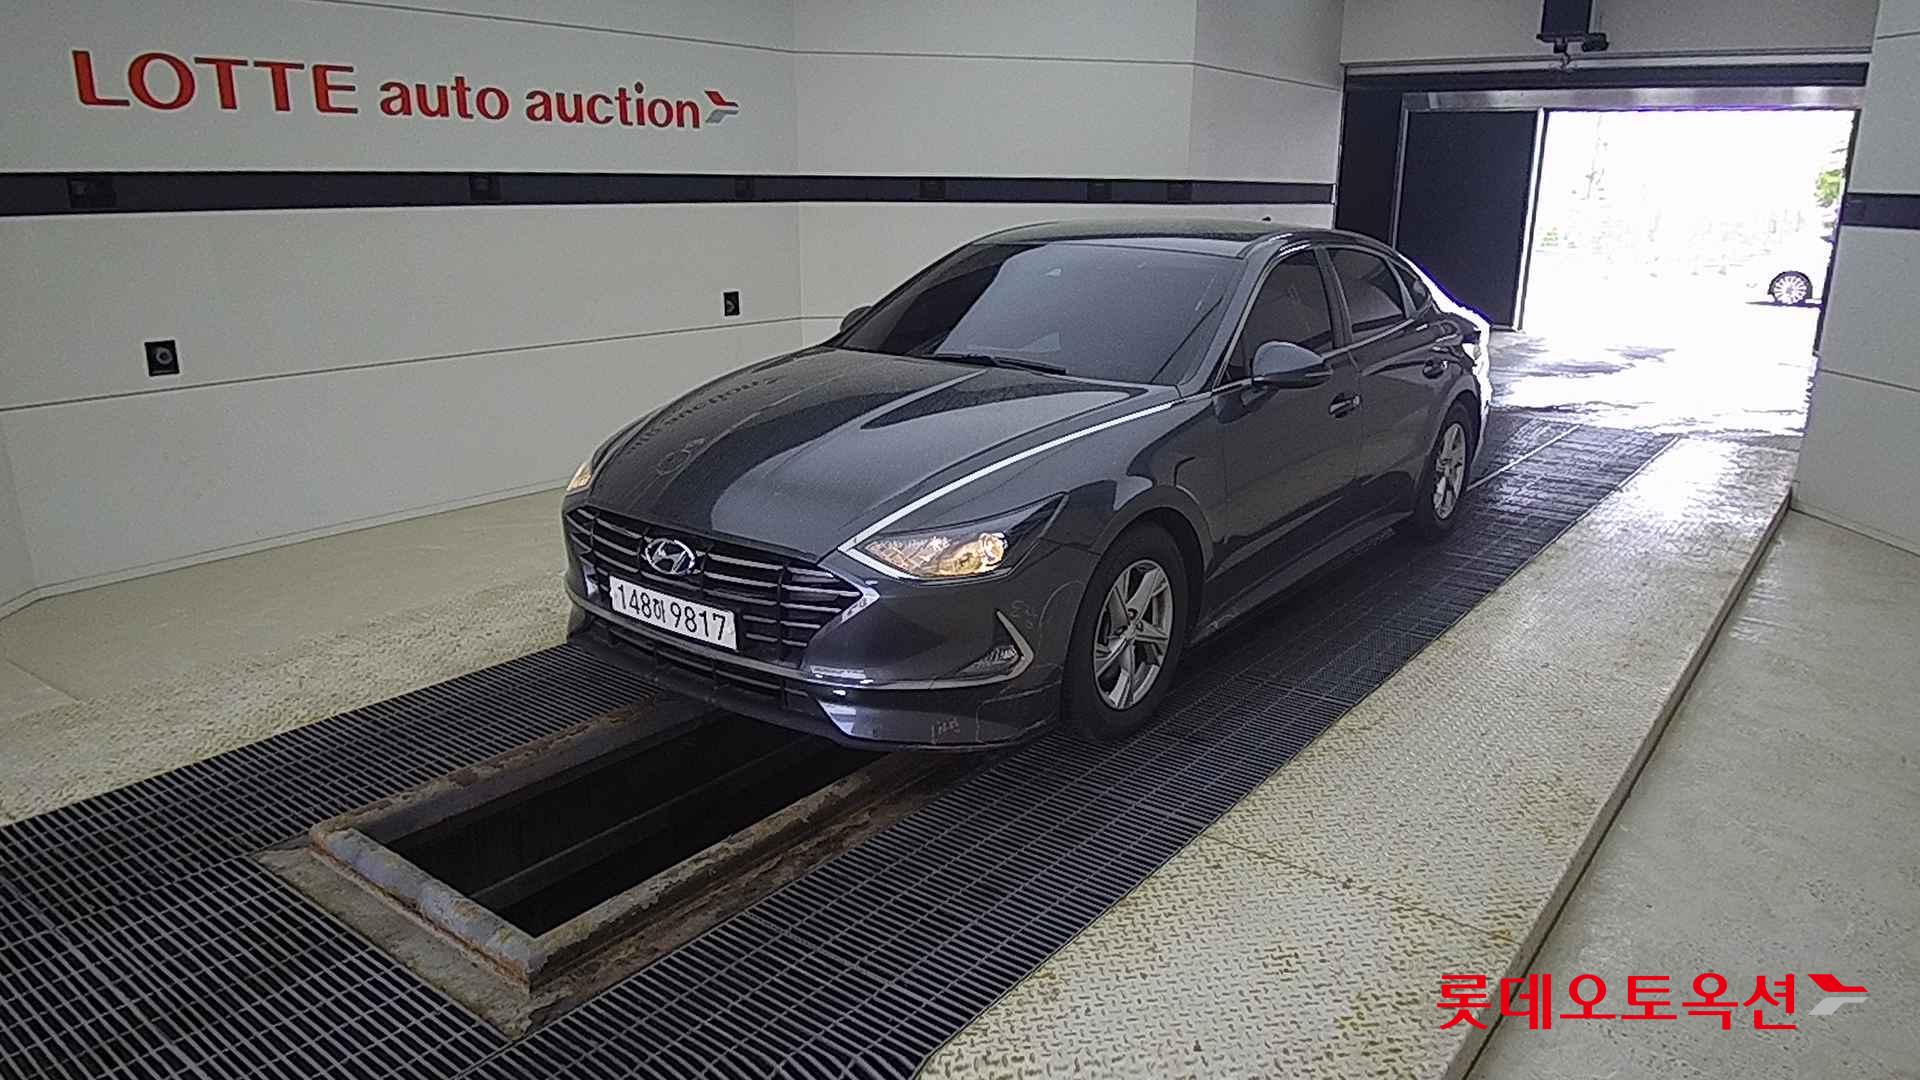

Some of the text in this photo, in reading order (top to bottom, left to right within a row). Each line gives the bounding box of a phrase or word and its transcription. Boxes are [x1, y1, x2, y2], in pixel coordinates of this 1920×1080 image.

[72, 50, 700, 128] LOTTE auto auction
